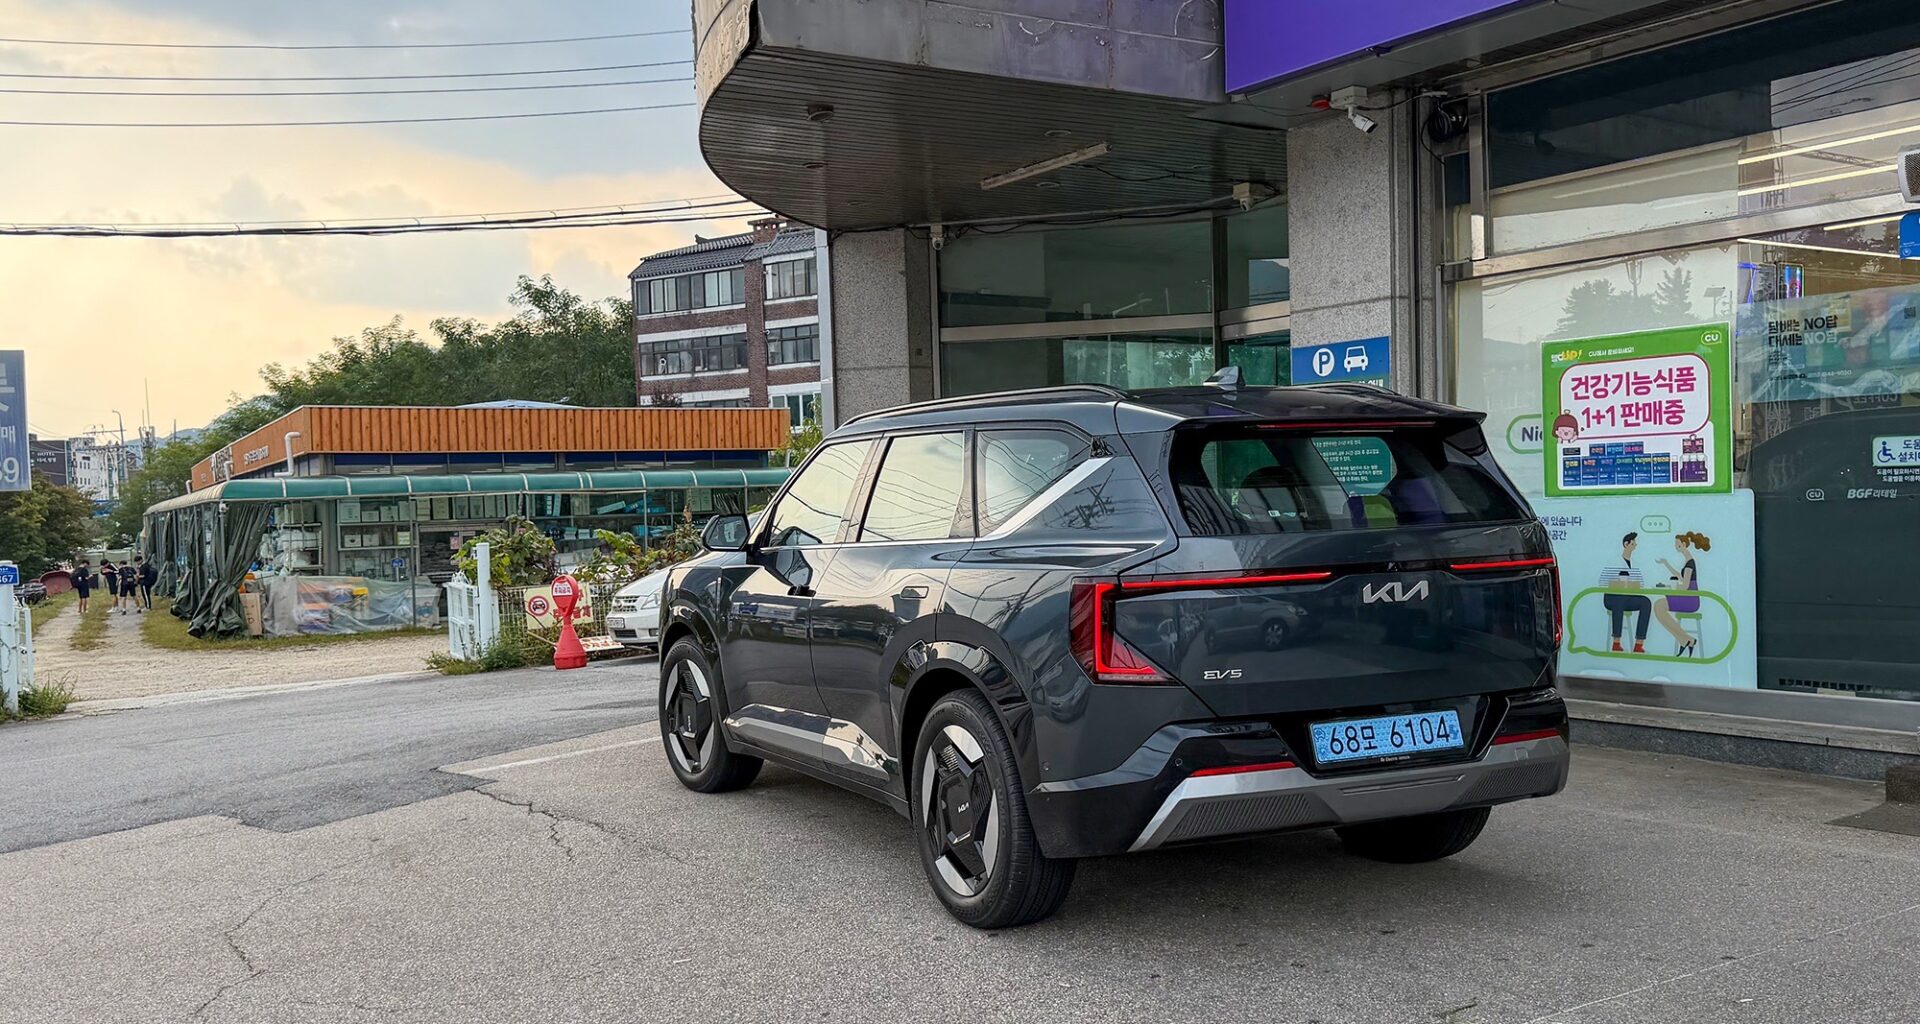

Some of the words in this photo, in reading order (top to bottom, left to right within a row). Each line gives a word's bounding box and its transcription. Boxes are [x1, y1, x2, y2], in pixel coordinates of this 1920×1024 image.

[1803, 314, 1838, 330] NO답
[1704, 333, 1719, 342] CU
[1570, 366, 1697, 400] 건강기능식품
[1581, 405, 1616, 429] 1+1
[1620, 399, 1686, 427] 판매중
[0, 456, 20, 483] 9
[1847, 488, 1898, 499] BGF리테일
[1550, 516, 1582, 527] 있습니다
[1549, 530, 1567, 540] 공간
[1363, 580, 1429, 604] KIA
[1203, 669, 1243, 680] EV5
[1329, 725, 1378, 755] 68모
[1389, 715, 1450, 748] 6104
